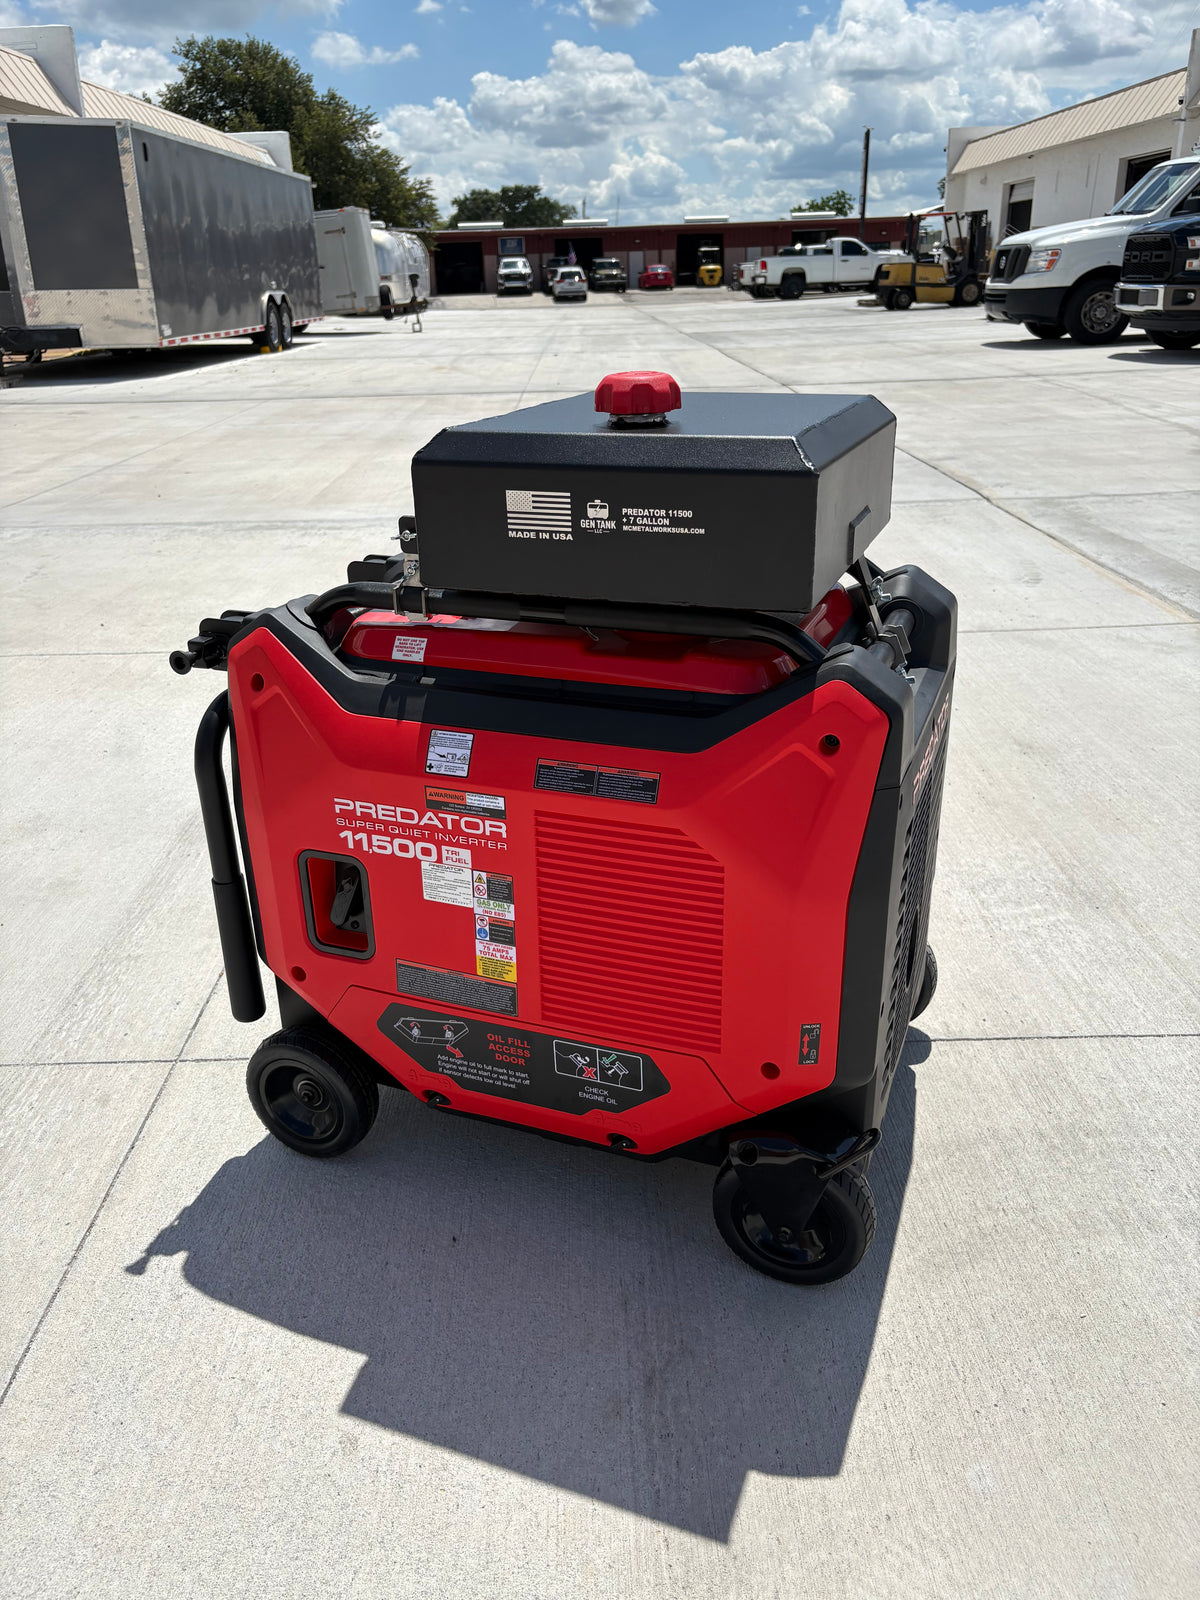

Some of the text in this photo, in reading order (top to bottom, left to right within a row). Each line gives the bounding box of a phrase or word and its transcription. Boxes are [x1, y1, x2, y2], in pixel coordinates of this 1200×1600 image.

[1124, 251, 1165, 263] FORD
[622, 508, 666, 516] PREDATOR
[581, 519, 616, 529] GEN TANK
[637, 517, 670, 525] GALLON
[623, 525, 705, 534] MCMETALWORKSUSA.COM
[508, 531, 536, 539] MADE
[913, 692, 949, 805] PREDATOR
[433, 791, 464, 801] WARNING
[334, 798, 507, 838] PREDATOR
[336, 818, 507, 850] SUPER QUIET INVERTER
[339, 830, 437, 862] 11,500
[445, 849, 460, 857] TRI
[445, 856, 469, 865] FUEL
[493, 901, 510, 910] ONLY
[494, 911, 506, 919] E85)
[479, 950, 498, 958] TOTAL
[487, 1033, 530, 1049] OIL FILL
[488, 1043, 530, 1058] ACCESS
[495, 1053, 525, 1066] DOOR
[438, 1061, 457, 1069] Engine
[449, 1057, 468, 1065] engine
[493, 1066, 507, 1074] mark
[463, 1073, 482, 1081] detects
[585, 1086, 609, 1096] CHECK
[579, 1091, 618, 1105] ENGINE OIL
